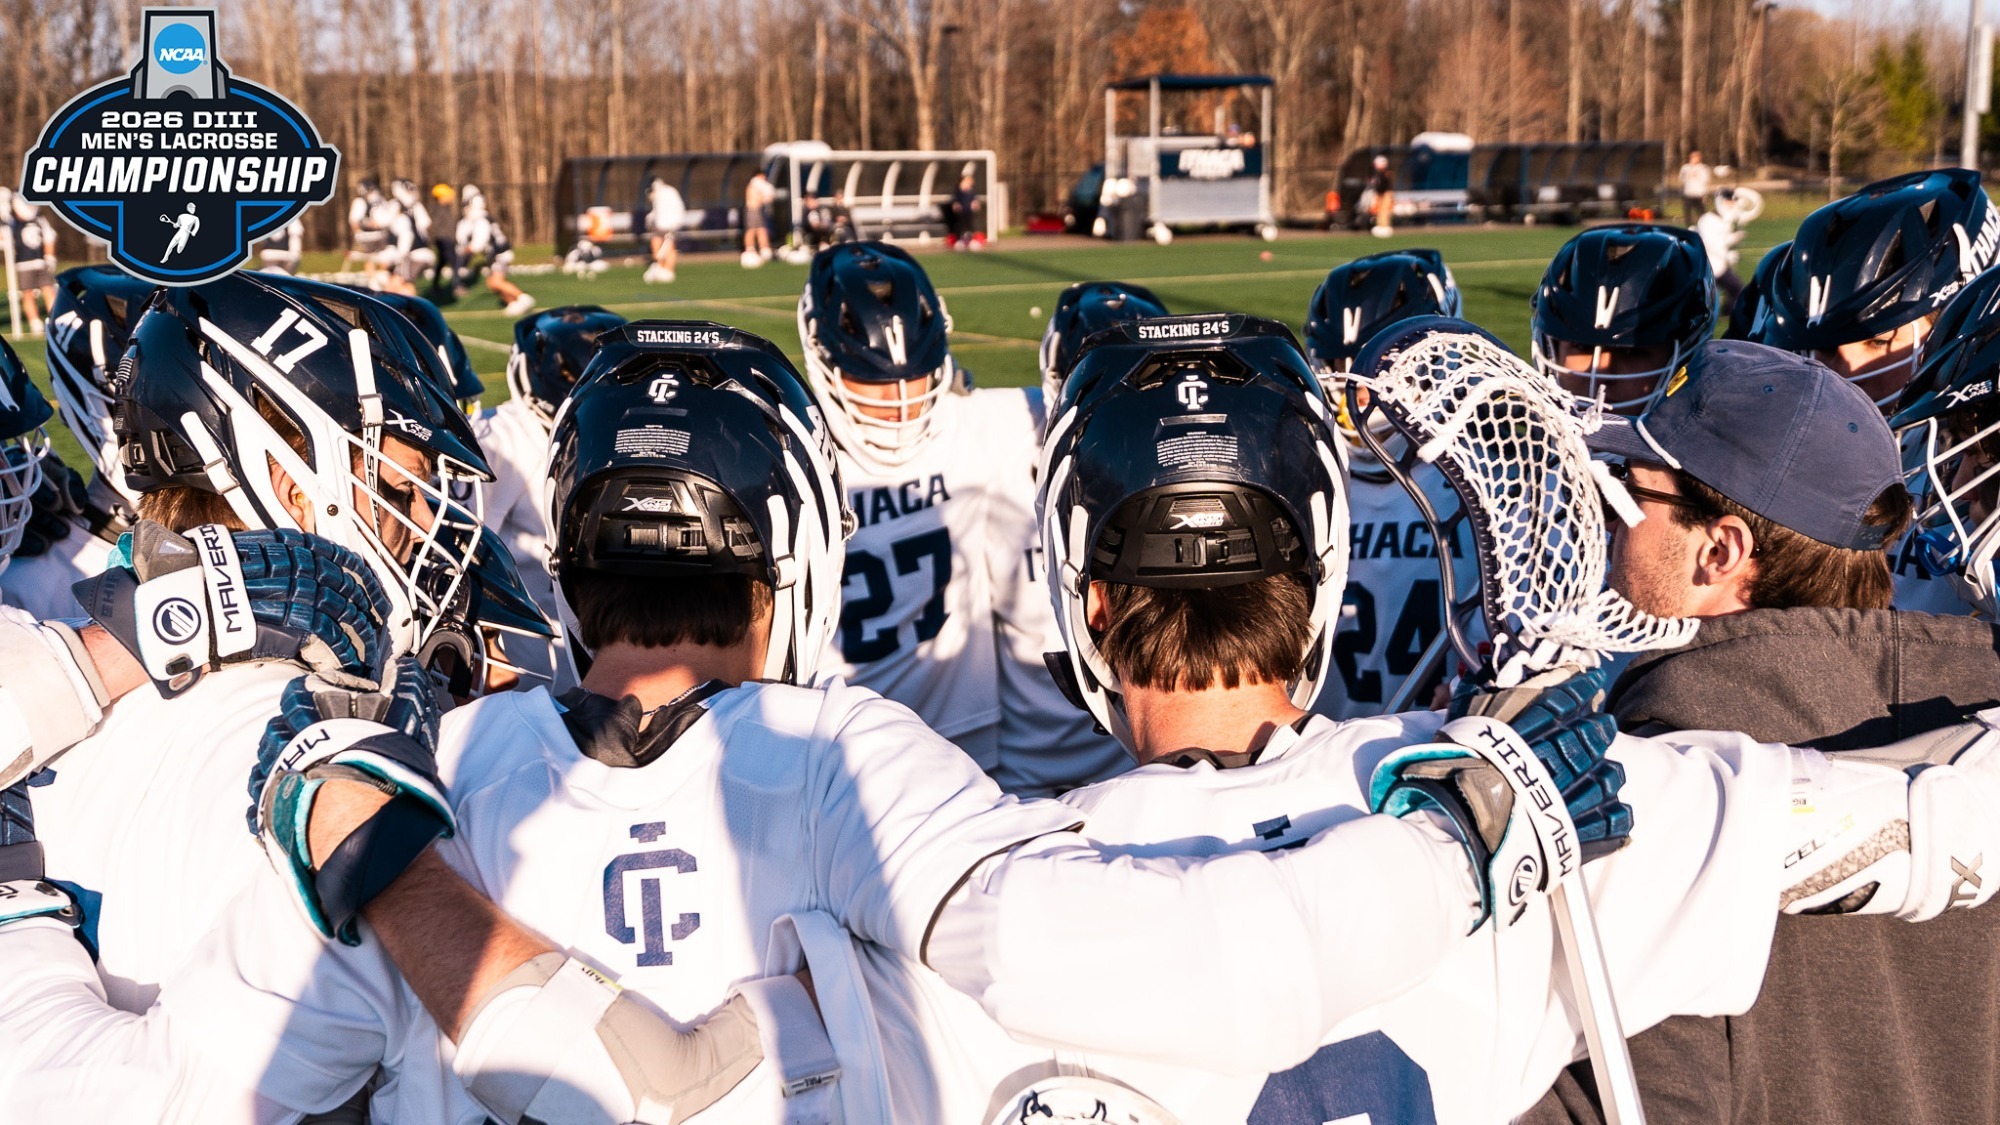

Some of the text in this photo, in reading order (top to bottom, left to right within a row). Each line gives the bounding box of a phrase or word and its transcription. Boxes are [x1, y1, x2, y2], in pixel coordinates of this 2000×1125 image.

[251, 307, 329, 374] 17
[637, 329, 720, 344] STACKING 24'S
[1139, 320, 1230, 338] STACKING 24'S
[199, 524, 243, 633] MAVERI
[1350, 521, 1464, 560] HACA
[840, 526, 952, 664] 27
[1333, 579, 1447, 707] 24
[1478, 724, 1573, 877] MAVERIK
